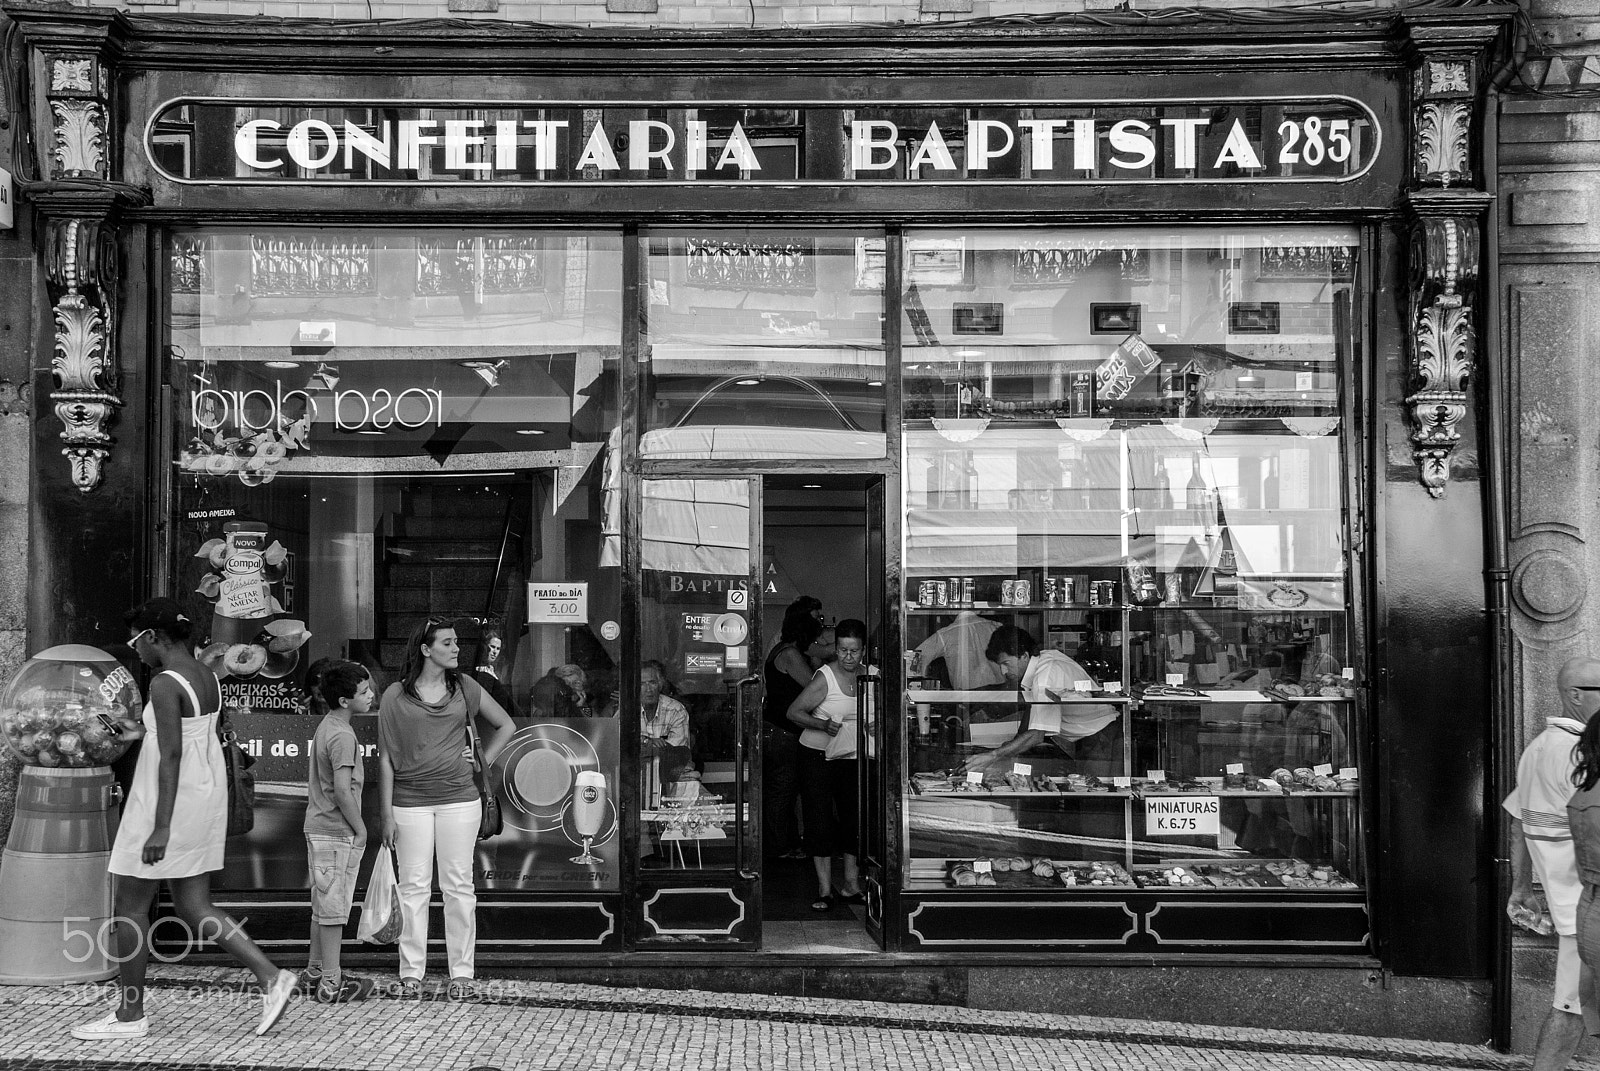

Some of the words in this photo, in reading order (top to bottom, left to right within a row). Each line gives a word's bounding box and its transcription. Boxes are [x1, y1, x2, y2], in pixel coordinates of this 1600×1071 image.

[234, 119, 762, 171] CONFEITARIA
[851, 117, 1262, 171] BAPTISTA
[1277, 116, 1351, 168] 285
[188, 511, 208, 519] NOVO
[208, 508, 236, 518] AMEIXA
[228, 558, 261, 570] Compal
[533, 589, 557, 598] PRATO
[549, 602, 577, 614] 3.00
[685, 615, 711, 624] ENTRE
[221, 683, 277, 697] AMEIXAS
[270, 739, 299, 757] de
[1147, 801, 1218, 814] MINIATURAS
